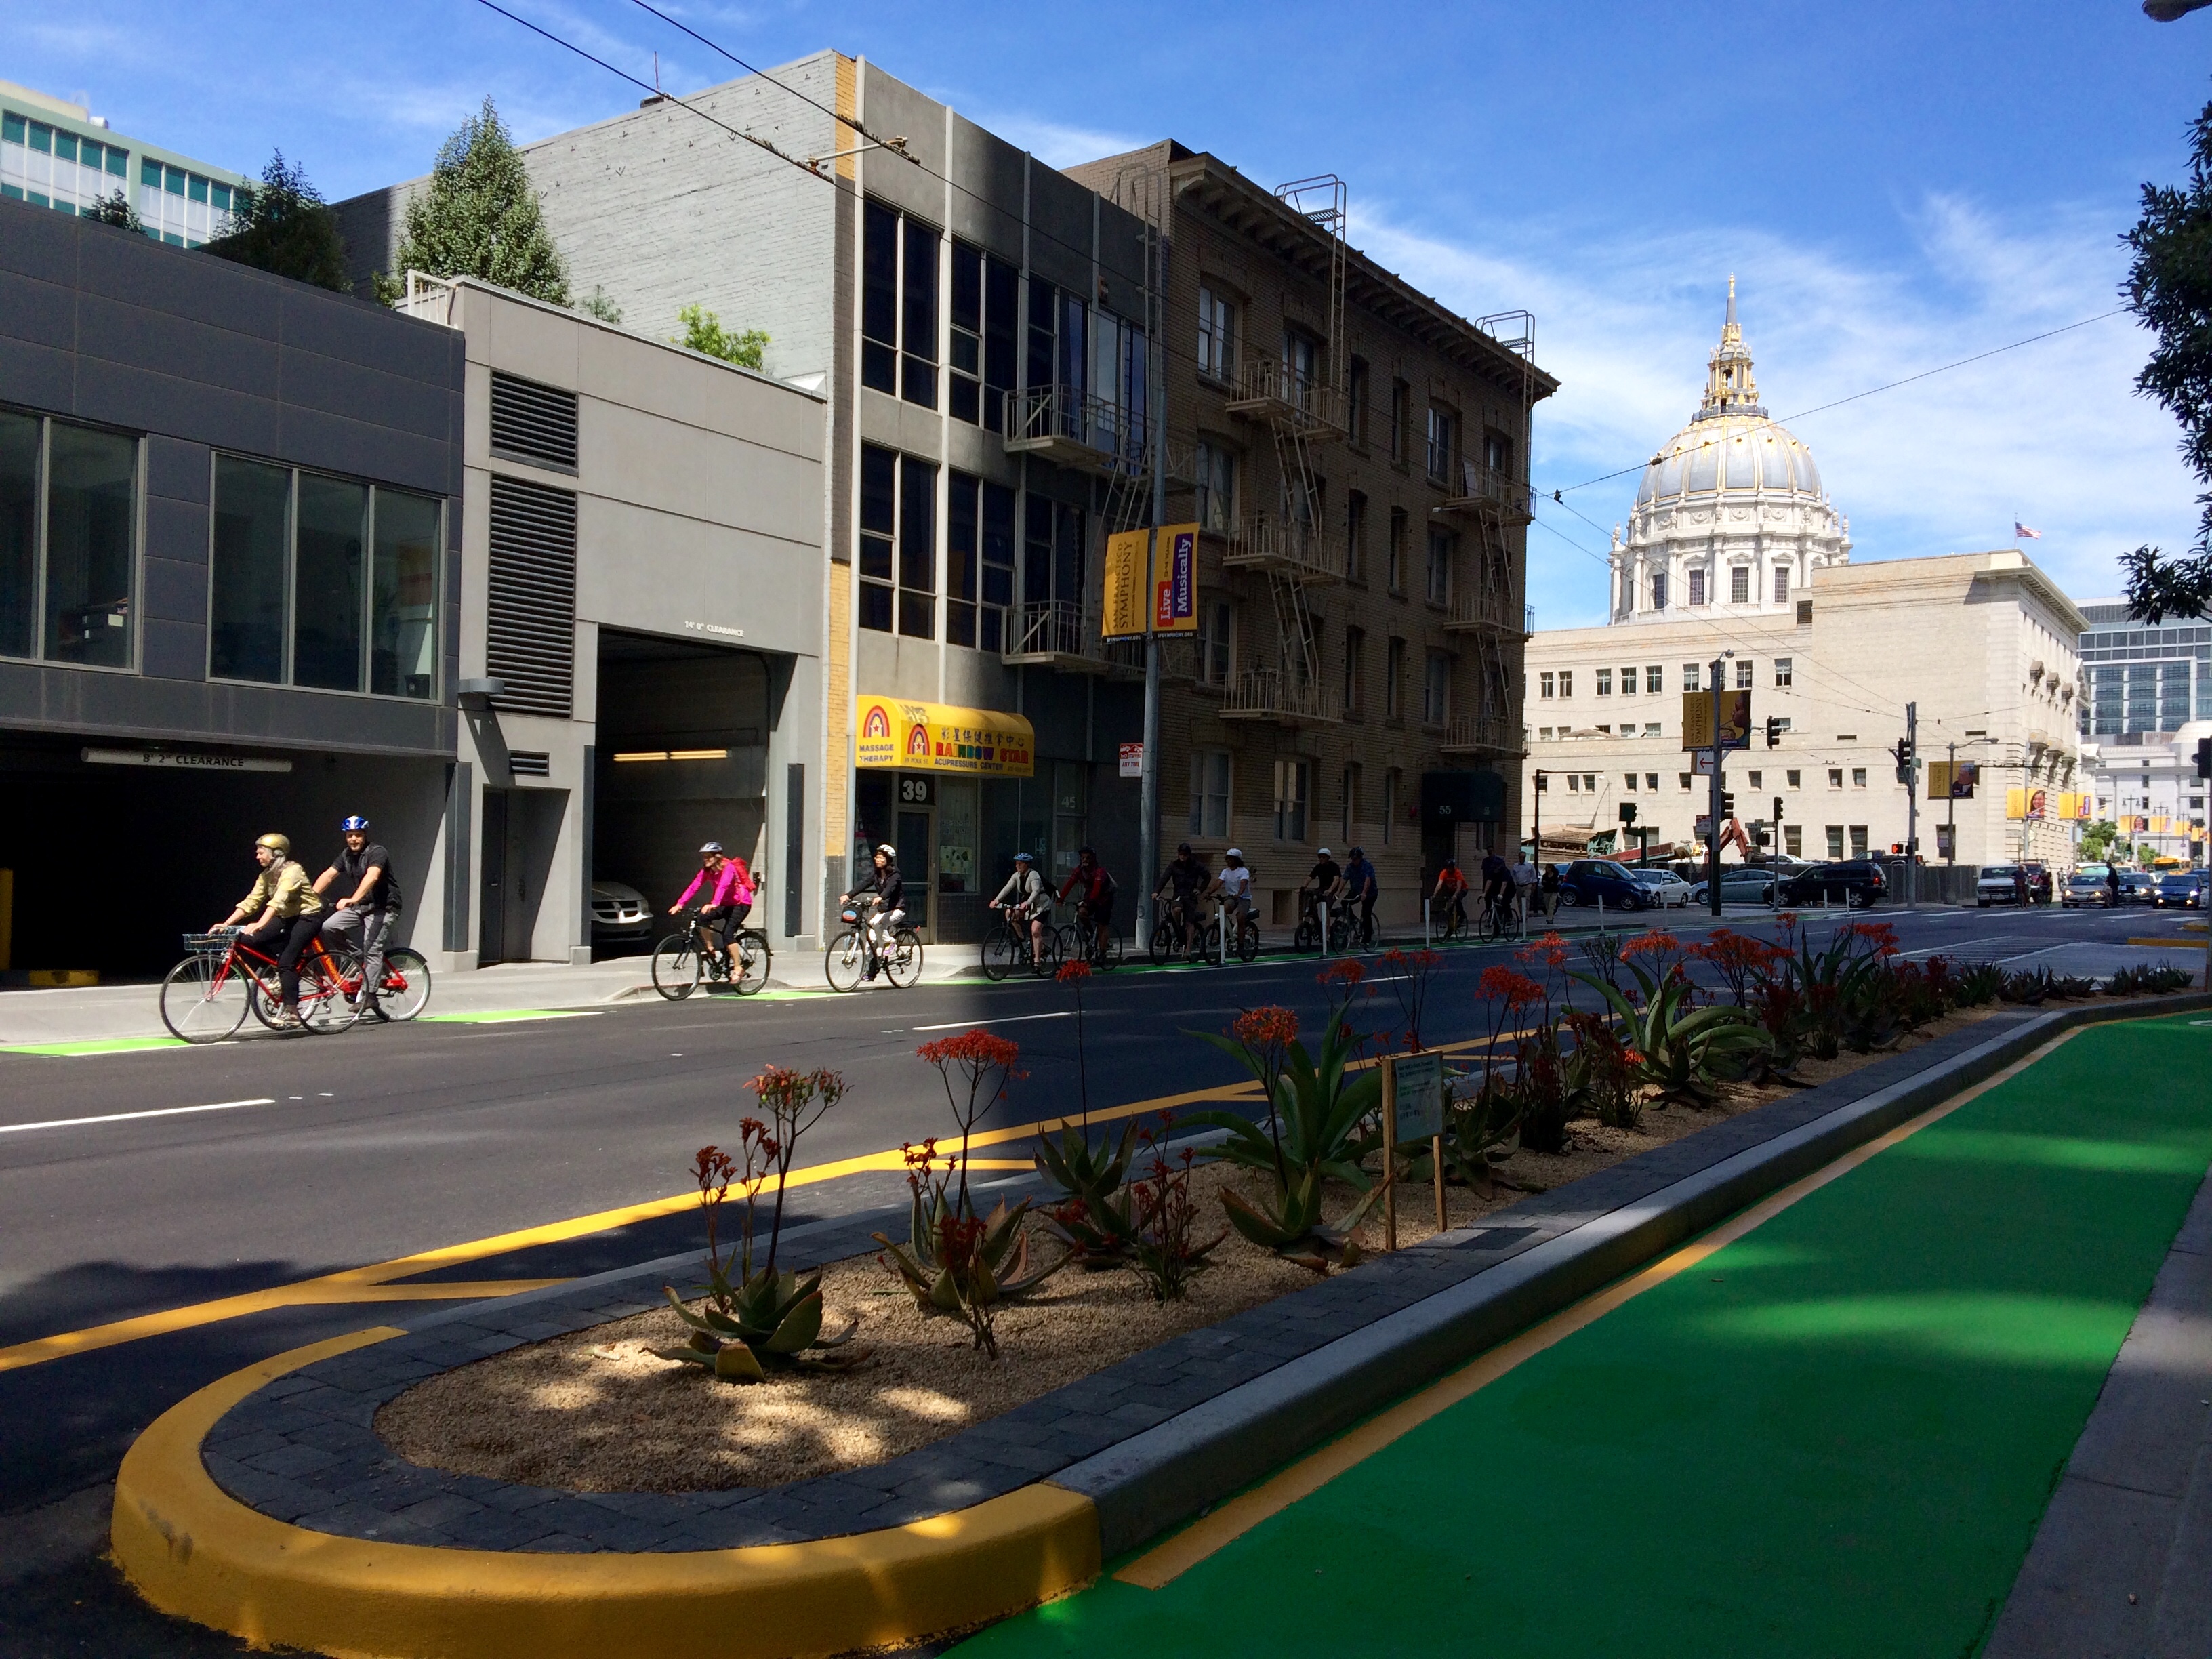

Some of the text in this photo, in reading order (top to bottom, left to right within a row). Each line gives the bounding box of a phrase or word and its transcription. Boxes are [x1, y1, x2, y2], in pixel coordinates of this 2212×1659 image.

[1113, 542, 1123, 604] FRANCISCO
[1177, 538, 1191, 613] Musically
[1119, 541, 1132, 628] SYMPHONY
[1160, 588, 1171, 620] Live
[707, 624, 745, 638] CLEARANCE
[176, 755, 244, 767] CLEARANCE
[935, 742, 1029, 764] RAINBOW STAR
[935, 758, 978, 769] ACUPRESSURE
[980, 762, 1004, 771] CENTER
[902, 779, 927, 802] 39
[1061, 796, 1076, 808] 45
[1439, 806, 1452, 815] 55
